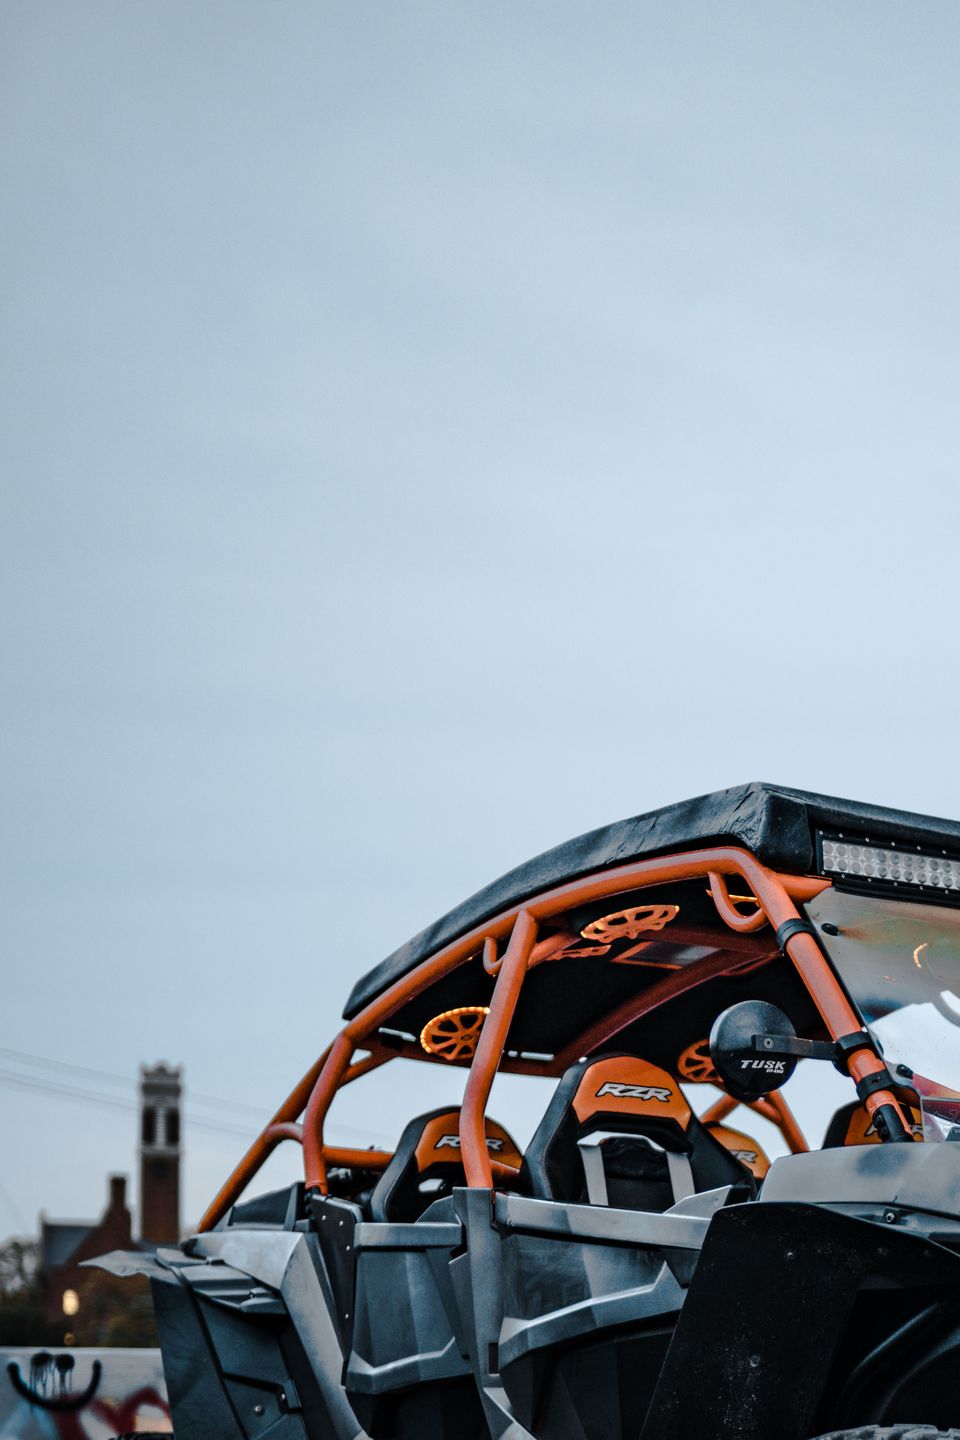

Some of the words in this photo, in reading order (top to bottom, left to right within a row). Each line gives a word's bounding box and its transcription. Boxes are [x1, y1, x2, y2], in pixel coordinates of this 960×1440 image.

[740, 1060, 787, 1070] TUSK
[596, 1082, 673, 1102] RZR
[433, 1134, 504, 1152] RR
